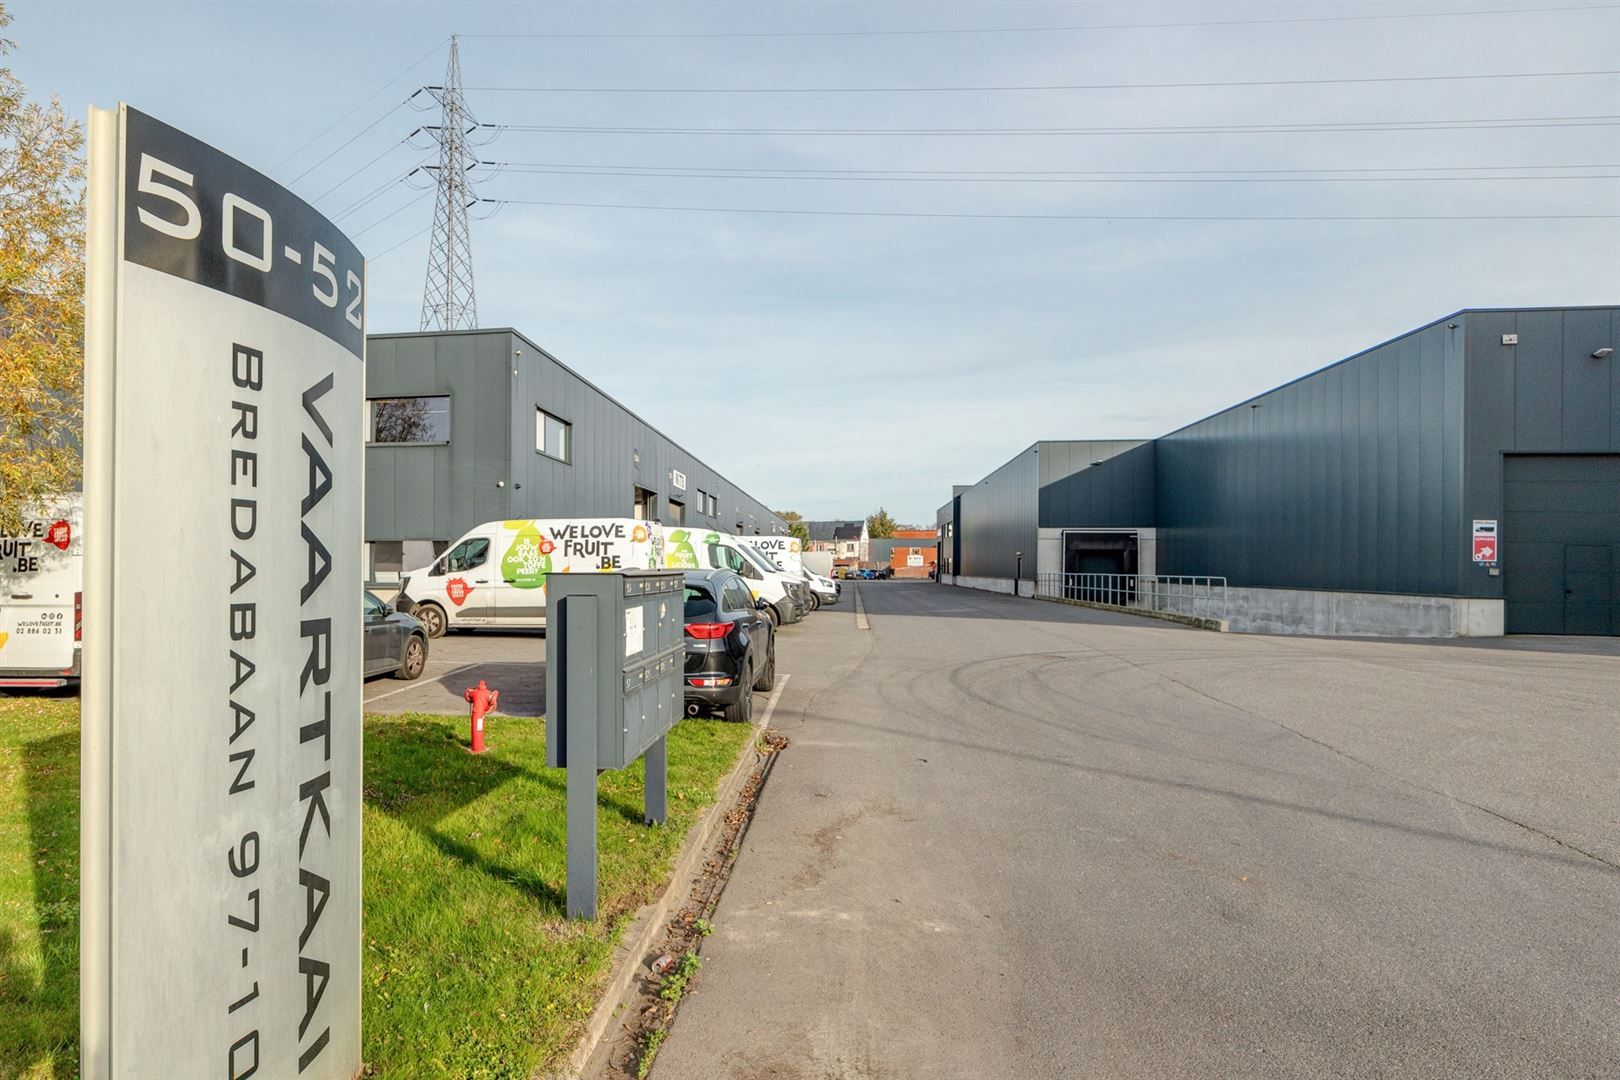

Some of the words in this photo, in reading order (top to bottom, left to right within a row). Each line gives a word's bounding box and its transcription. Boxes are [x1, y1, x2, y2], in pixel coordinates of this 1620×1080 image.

[137, 152, 362, 330] 50-52
[564, 539, 614, 558] FRUIT
[12, 557, 39, 573] .BE
[229, 342, 263, 796] BREDABAAN
[596, 555, 622, 570] .BE
